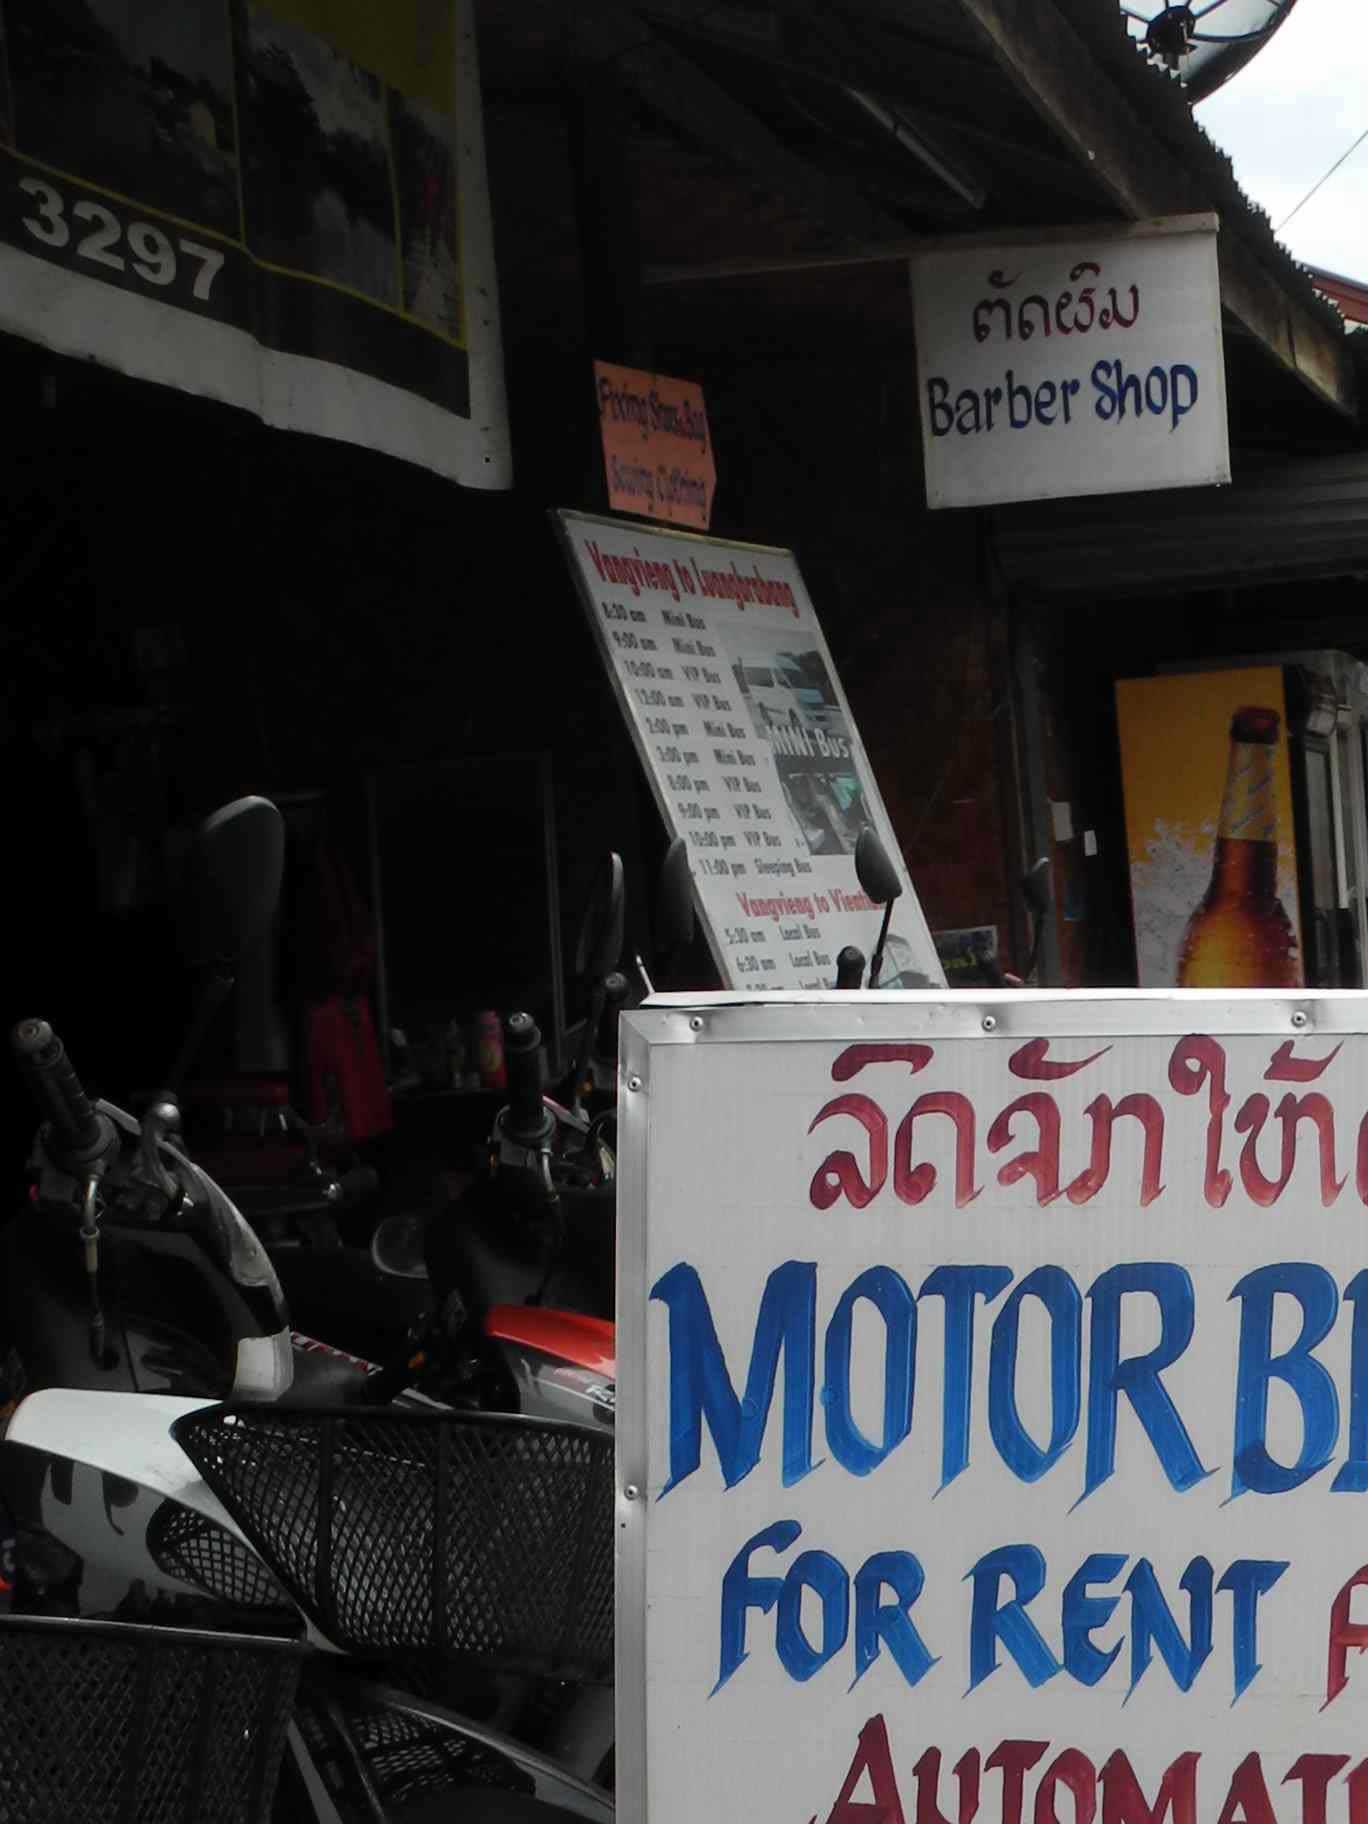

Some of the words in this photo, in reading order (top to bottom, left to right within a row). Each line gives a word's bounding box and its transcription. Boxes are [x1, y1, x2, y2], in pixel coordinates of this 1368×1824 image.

[17, 177, 225, 302] 3297
[925, 369, 1080, 437] Barber
[1091, 358, 1199, 433] Shop
[960, 1544, 1290, 1708] RENT
